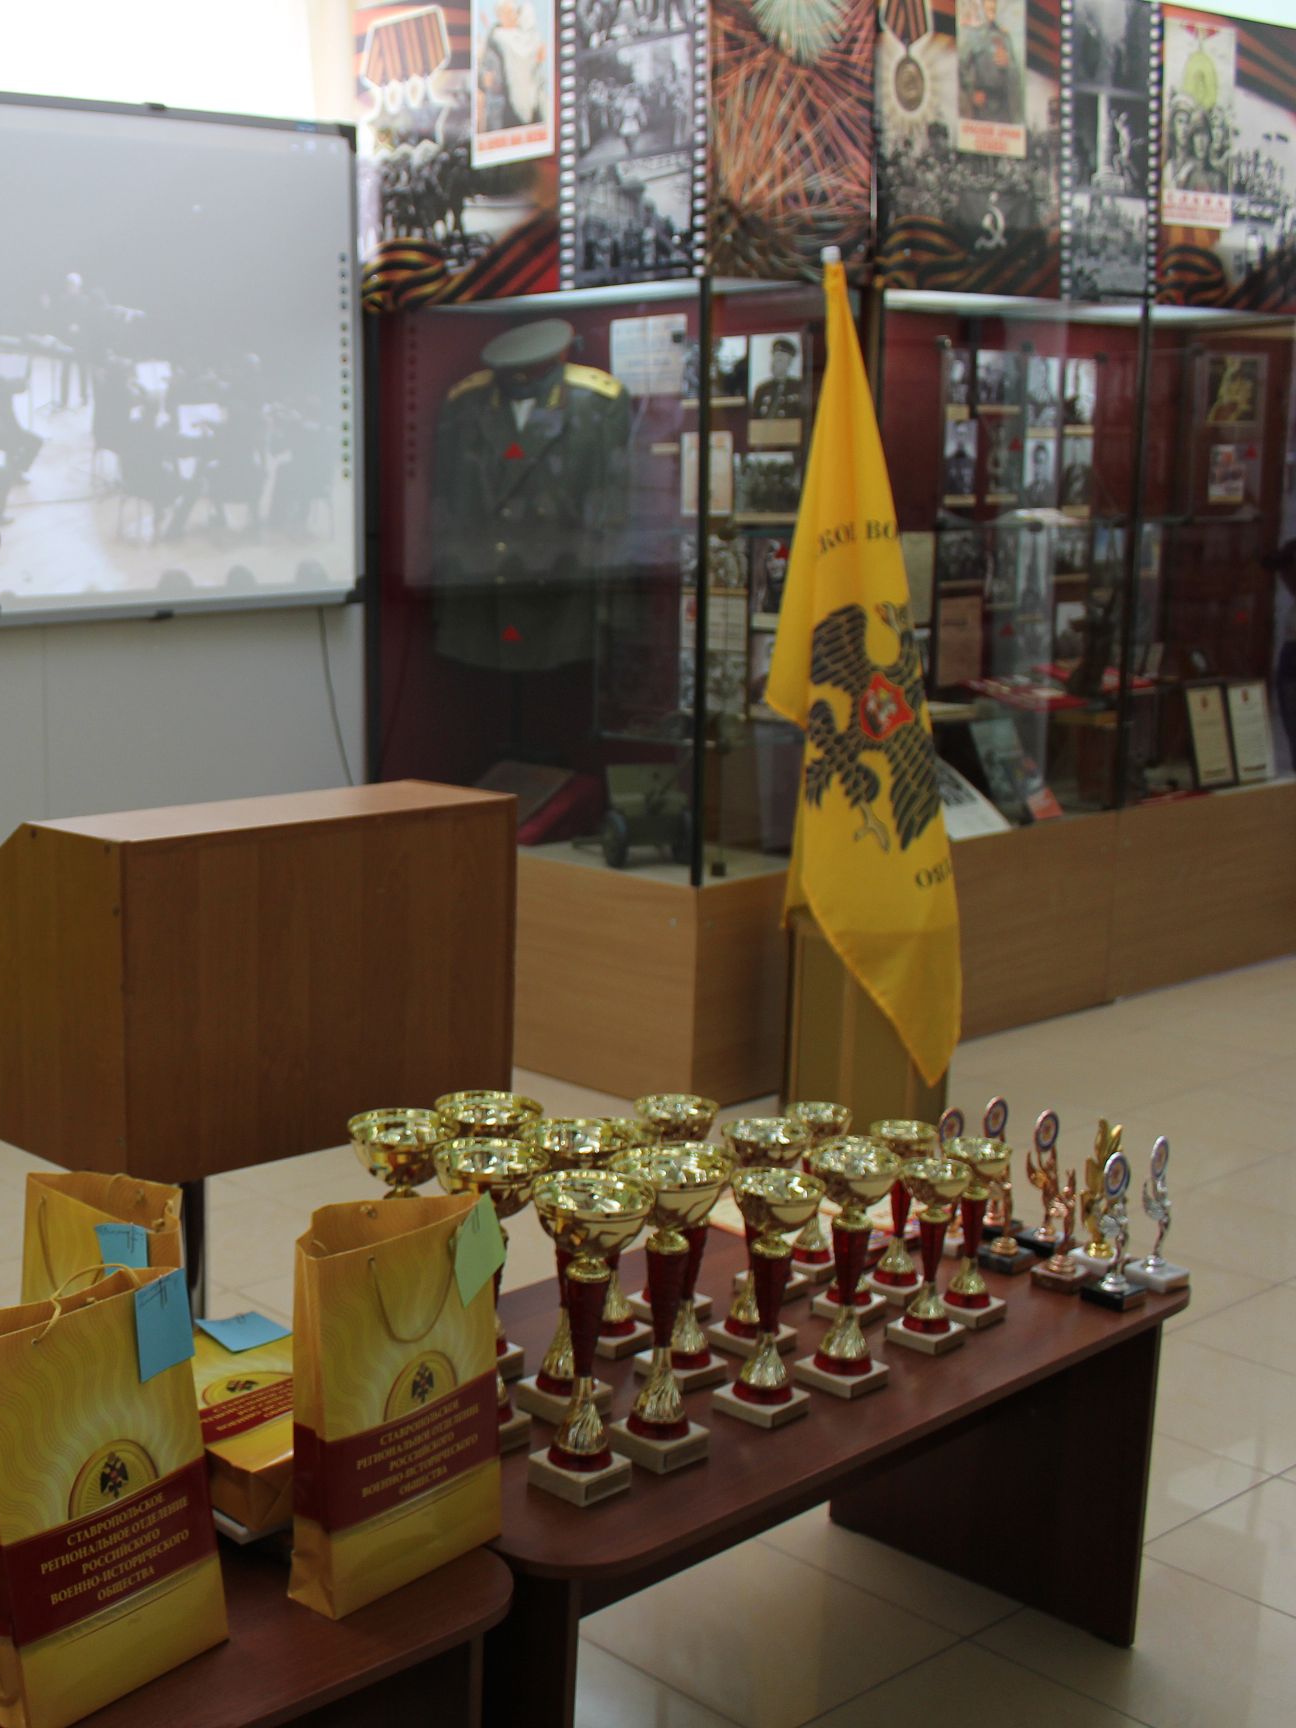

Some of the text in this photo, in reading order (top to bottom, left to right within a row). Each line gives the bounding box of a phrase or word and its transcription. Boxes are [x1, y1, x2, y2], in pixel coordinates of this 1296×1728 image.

[40, 1495, 189, 1575] РЕГИОНАЛЬНОЕ ОТДЕЛЕНИЕ
[66, 1492, 164, 1547] СТАВРОПОЛЬСКОЕ
[50, 1529, 190, 1605] ВОЕННО-ИСТОРИЧЕСКОГО
[81, 1528, 161, 1574] РОССИЙСКОГО
[97, 1565, 156, 1601] ОБЩЕСТВА
